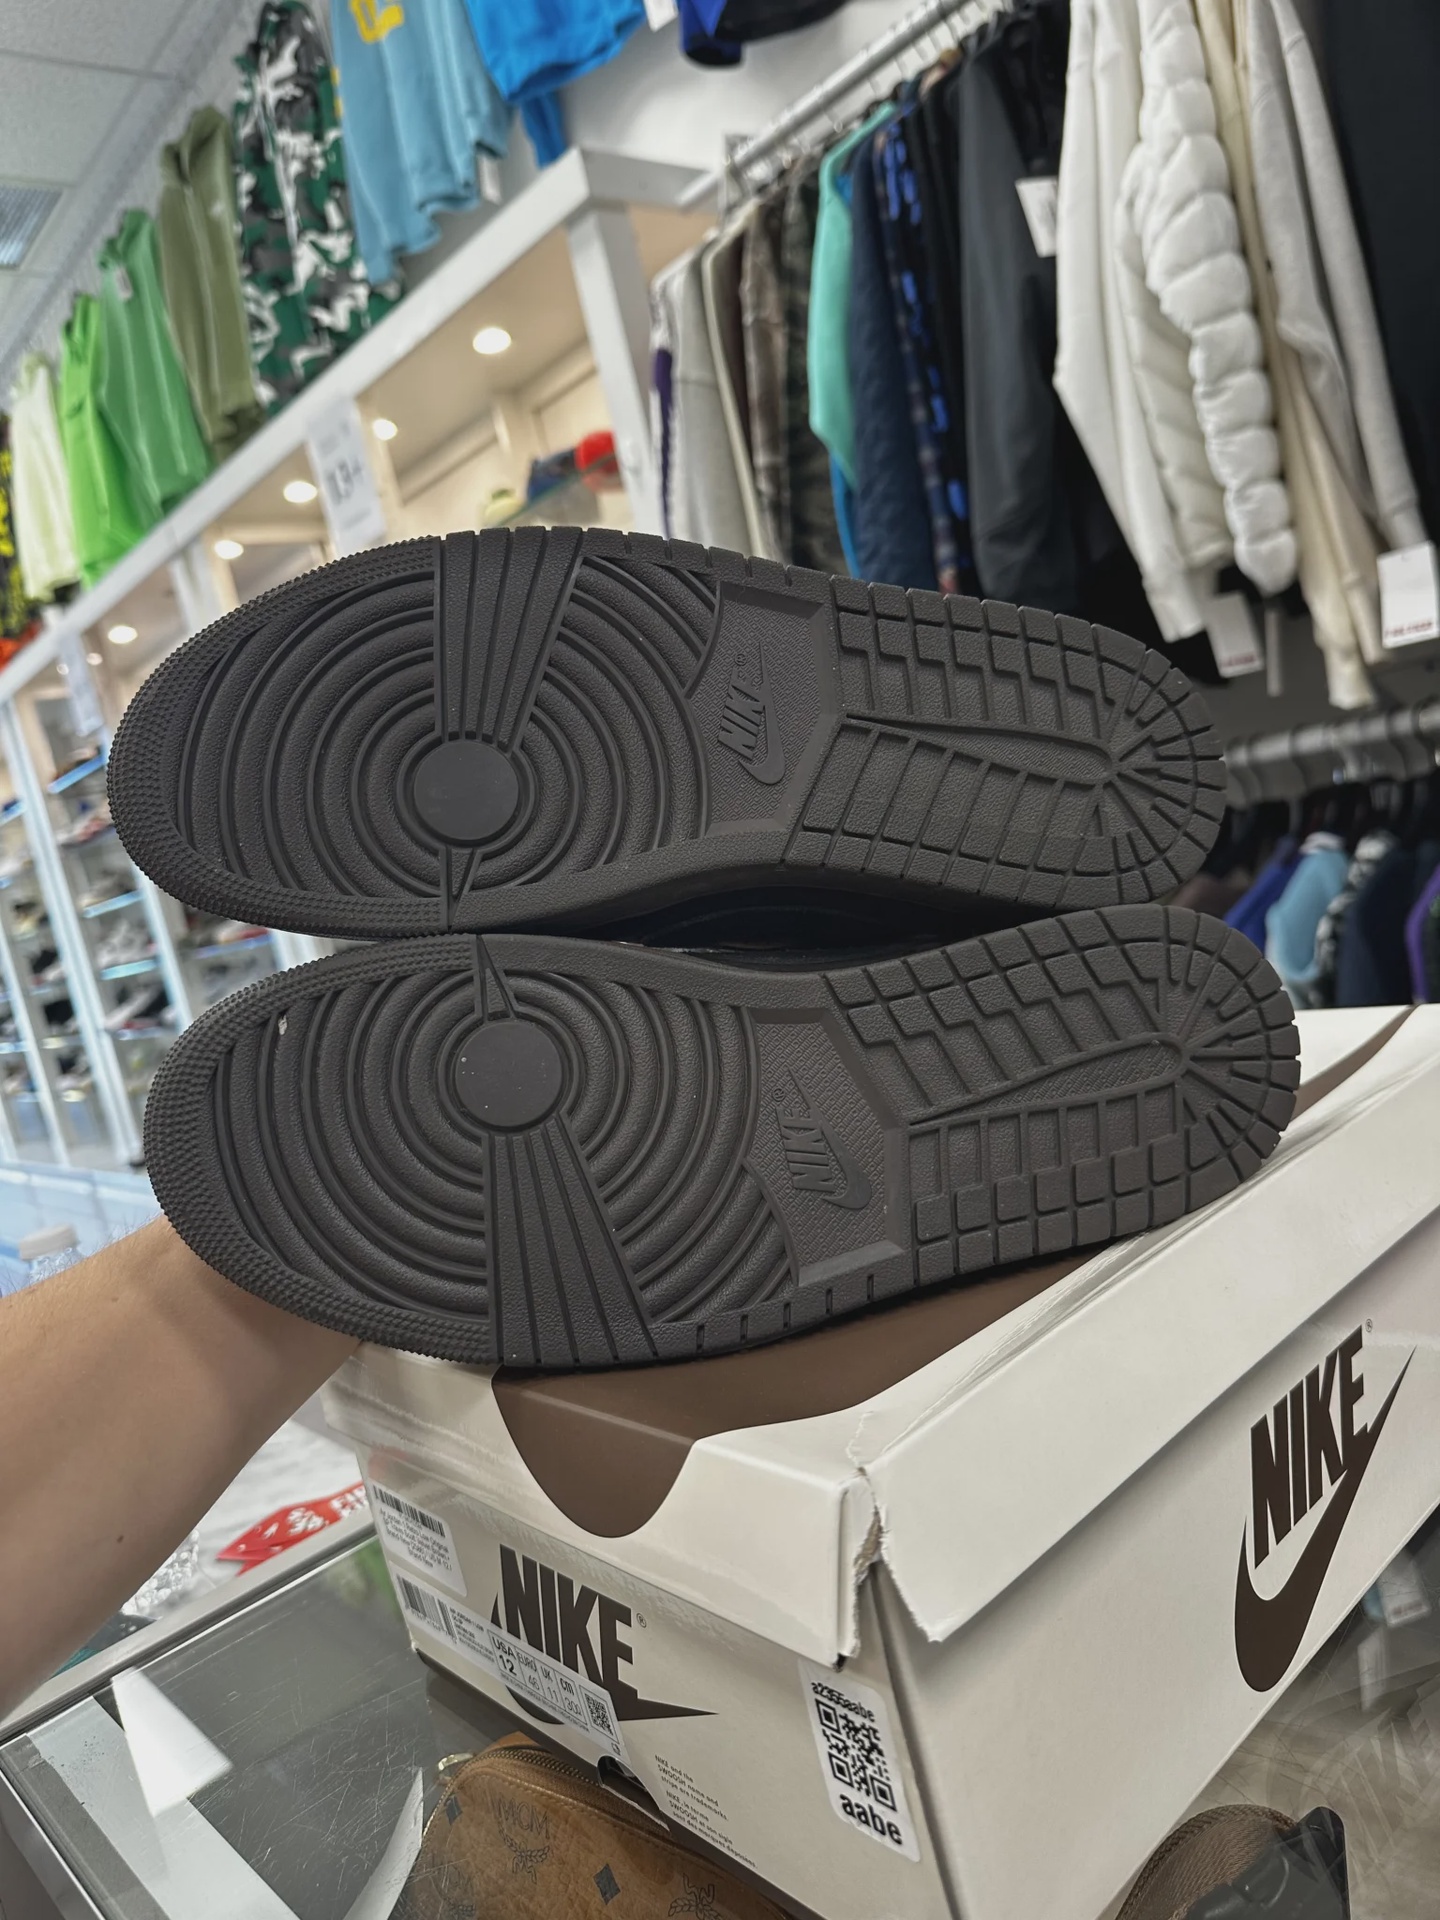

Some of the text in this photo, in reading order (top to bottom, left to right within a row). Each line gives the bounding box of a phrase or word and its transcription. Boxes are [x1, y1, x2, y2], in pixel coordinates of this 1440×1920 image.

[717, 666, 764, 762] NIKE
[775, 1106, 836, 1194] NIKE
[1250, 1324, 1368, 1570] NIKE
[500, 1543, 638, 1700] NIKE
[492, 1636, 517, 1661] USA
[517, 1651, 538, 1673] EURO
[540, 1665, 553, 1682] UK
[499, 1654, 518, 1676] 12
[547, 1686, 559, 1703] 11
[655, 1754, 694, 1783] NIKE and the
[657, 1764, 719, 1807] SWOOSH name and
[661, 1775, 729, 1821] stripe are trademarks.
[690, 1805, 709, 1822] terme
[840, 1793, 903, 1845] aabe
[669, 1800, 698, 1823] SWOOSH
[706, 1825, 718, 1835] son
[718, 1832, 733, 1845] sigle
[686, 1819, 698, 1831] des
[698, 1827, 726, 1848] marques
